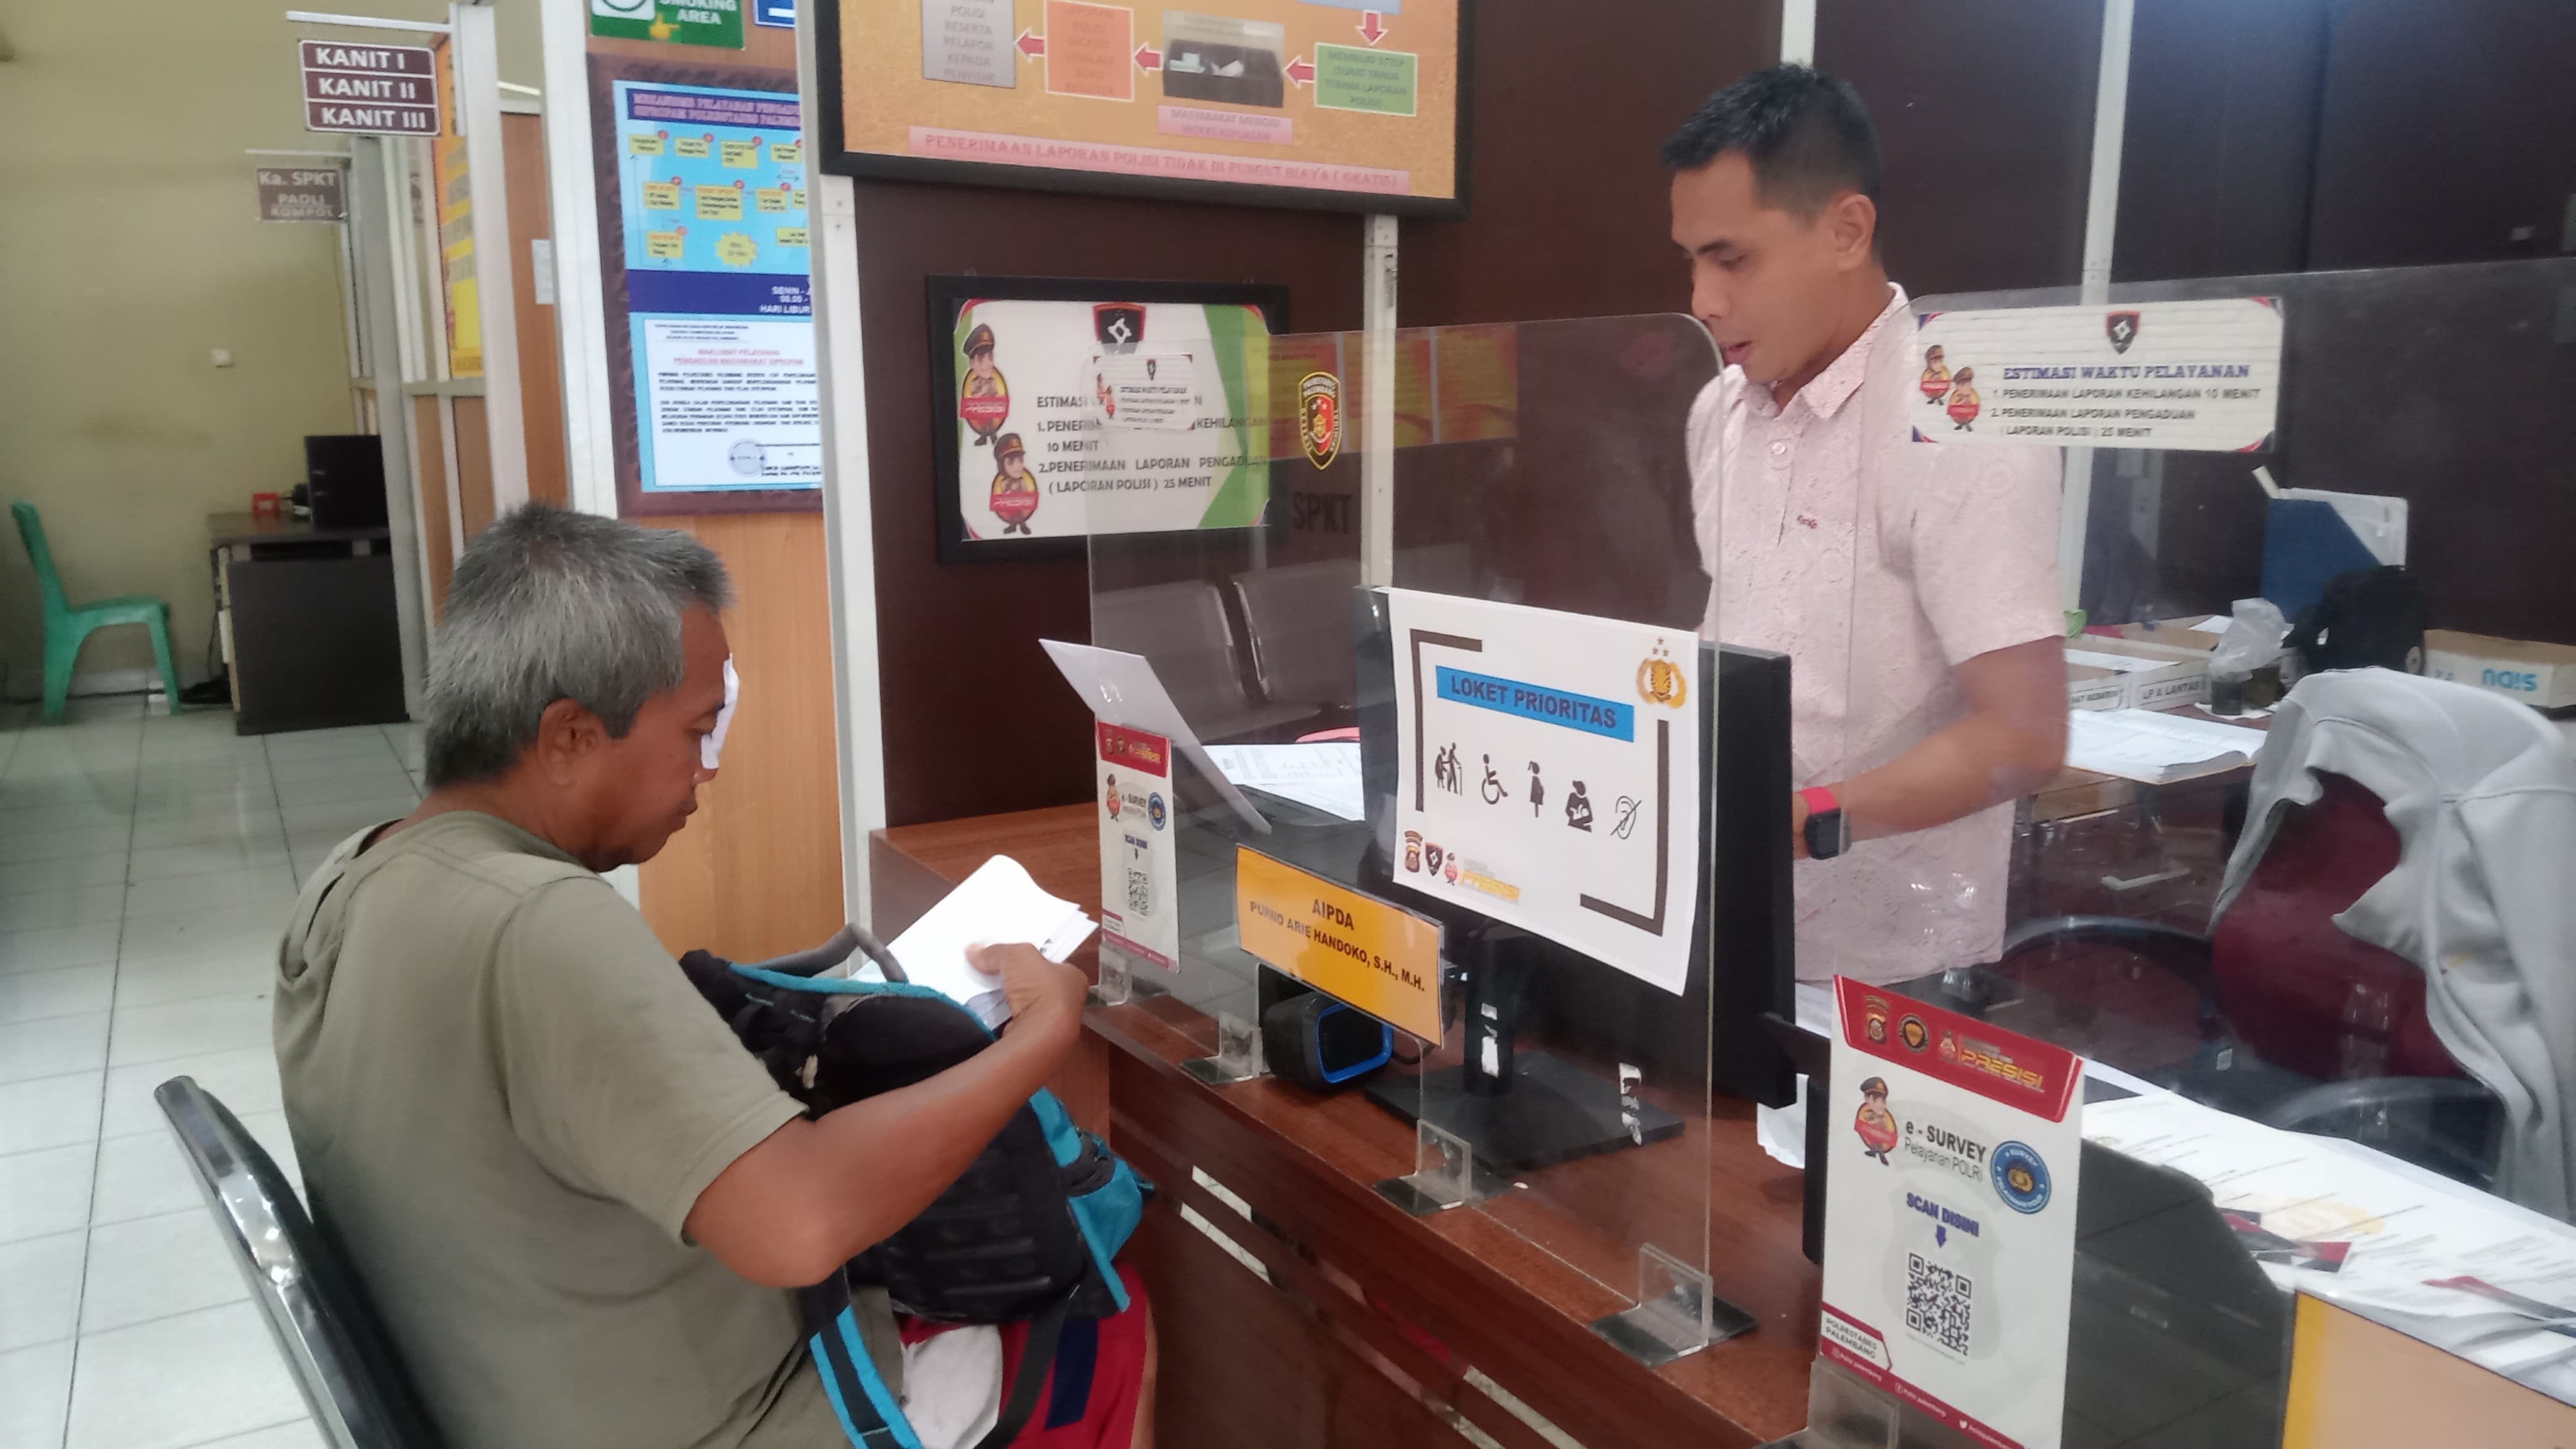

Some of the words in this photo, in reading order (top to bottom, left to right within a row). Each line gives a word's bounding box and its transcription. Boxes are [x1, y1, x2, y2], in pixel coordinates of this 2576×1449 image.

[676, 9, 722, 25] AREA
[951, 5, 985, 18] POLISI
[945, 21, 993, 35] BESERTA
[943, 36, 994, 50] PELAPOR
[316, 48, 390, 68] KANIT
[397, 53, 405, 69] I
[947, 54, 991, 66] KEPADA
[319, 78, 393, 98] KANIT
[400, 82, 416, 99] II
[321, 107, 396, 127] KANIT
[402, 111, 427, 128] III
[926, 134, 1032, 156] PENERIMAAN
[1036, 144, 1110, 163] LAPORAN
[1114, 152, 1159, 168] POLISI
[1163, 156, 1205, 170] TIDAK
[1212, 161, 1225, 172] DI
[1285, 168, 1330, 182] BIAYA
[259, 171, 287, 186] Ka.
[292, 171, 336, 186] SPKT
[270, 207, 333, 219] KOMPOL
[771, 286, 800, 294] SENIN
[759, 305, 782, 313] HARI
[783, 305, 811, 313] LIBUR
[2003, 366, 2077, 380] ESTIMASI
[2081, 366, 2140, 379] WAKTU
[2145, 364, 2250, 379] PELAYANAN
[2003, 389, 2070, 399] PENERIMAAN
[2073, 389, 2123, 399] LAPORAN
[2127, 389, 2201, 399] KEHILANGAN
[2205, 389, 2218, 399] 10
[2222, 388, 2261, 399] MENIT
[2002, 408, 2067, 418] PENERIMAAN
[2071, 409, 2121, 419] LAPORAN
[2125, 409, 2195, 419] PENGADUAN
[2006, 425, 2053, 435] LAPORAN
[2057, 426, 2090, 437] POLISI
[2118, 427, 2151, 437] MENIT
[1048, 441, 1059, 452] 10
[1062, 439, 1099, 452] MENIT
[1135, 458, 1189, 470] LAPORAN
[1057, 479, 1114, 493] LAPORAN
[1116, 479, 1150, 492] POLISI
[1164, 478, 1175, 490] 25
[1177, 476, 1212, 488] MENIT
[1292, 490, 1352, 535] SPKT
[1451, 675, 1508, 704] LOKET
[1514, 688, 1617, 729] PRIORITAS
[1128, 793, 1147, 808] SURVEY
[1312, 898, 1354, 931] AIPDA
[1287, 919, 1312, 938] ARIE
[1313, 928, 1371, 968] HANDOKO,
[1373, 955, 1399, 981] S.H.,
[1401, 969, 1426, 992] M.H.
[1960, 1049, 2044, 1089] PRESISI
[1905, 1120, 1915, 1135] e
[1927, 1125, 1986, 1163] SURVEY
[1904, 1140, 1951, 1167] Pelayanan
[1952, 1157, 1984, 1182] POLRI
[1907, 1191, 1939, 1221] SCAN
[1941, 1207, 1980, 1238] DISINI
[1825, 1316, 1878, 1350] POLRESTABES
[1825, 1325, 1877, 1360] PALEMBANG
